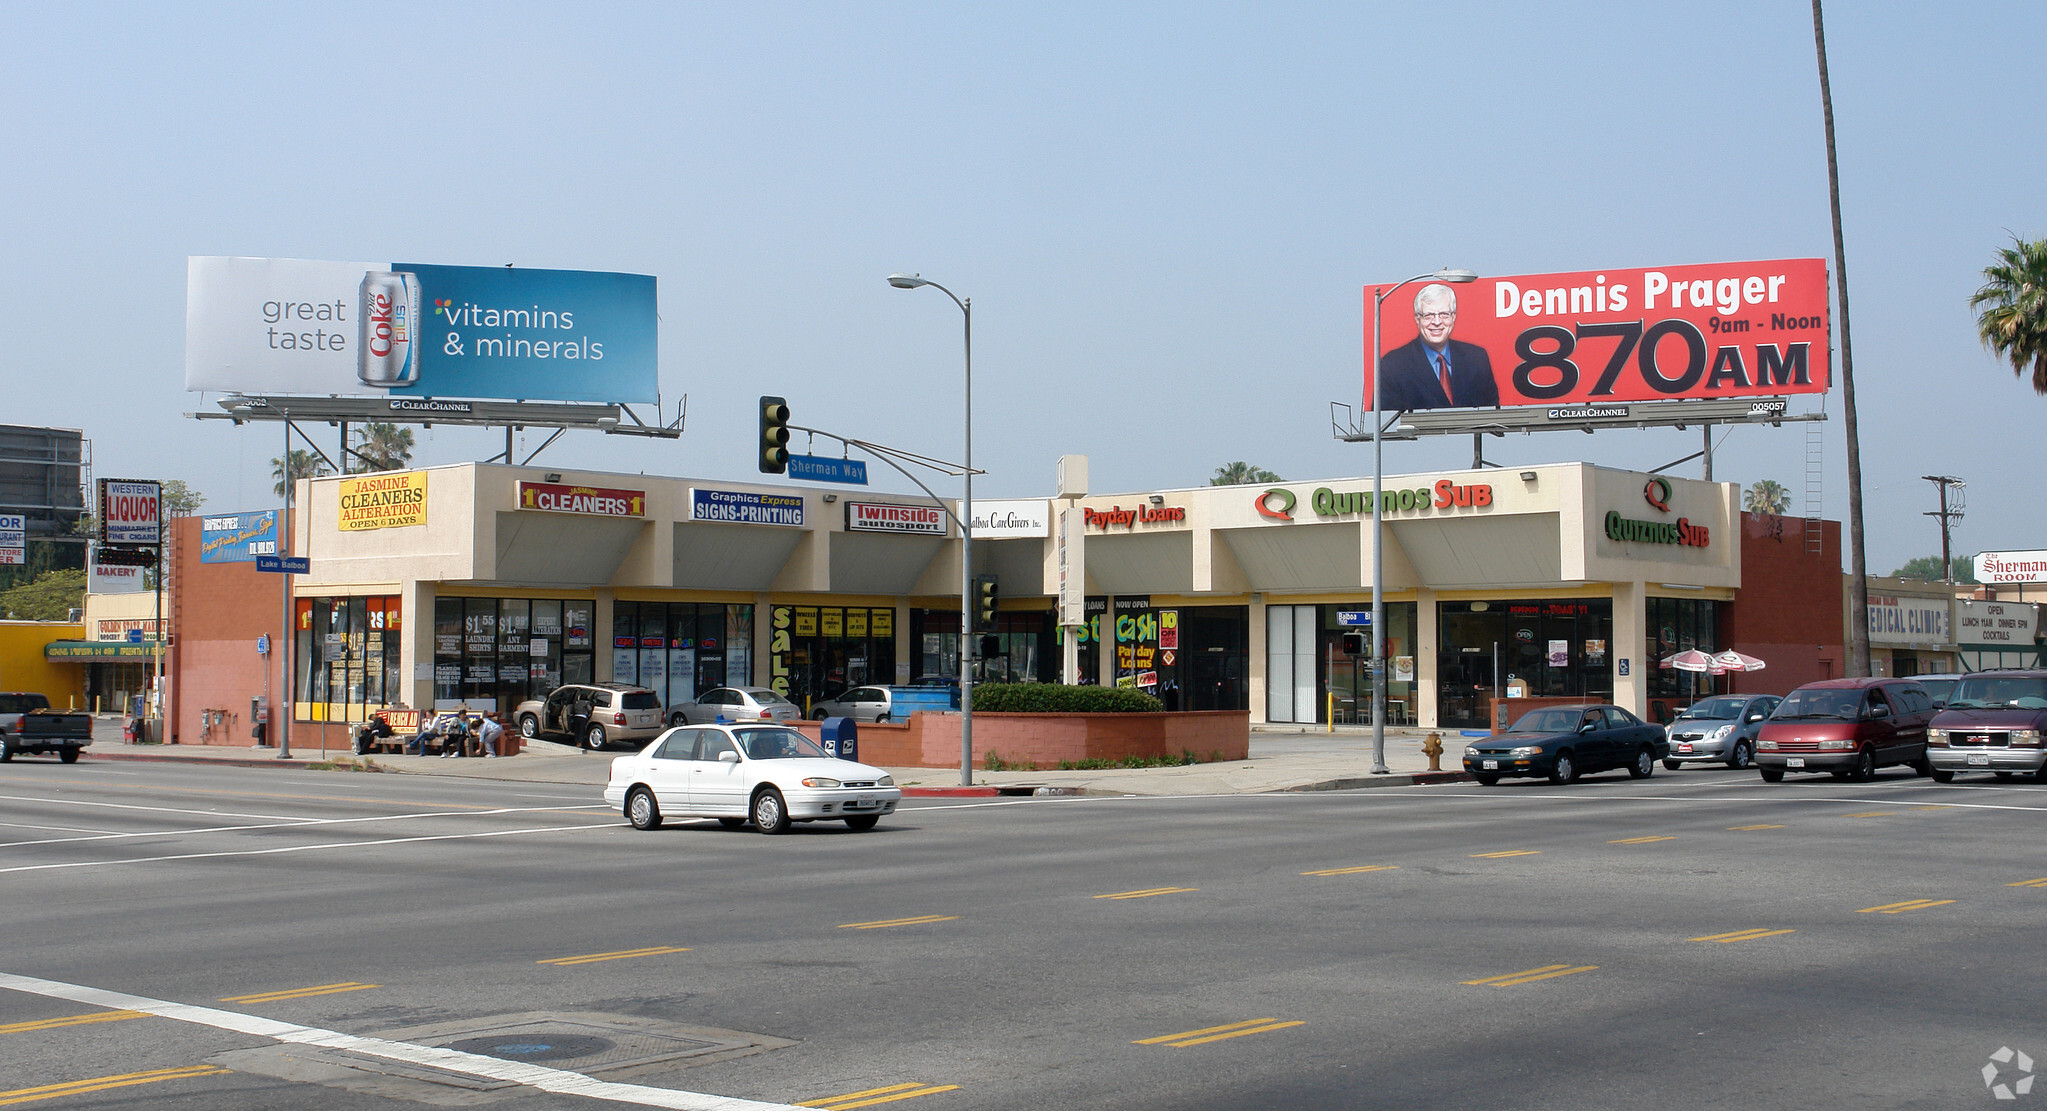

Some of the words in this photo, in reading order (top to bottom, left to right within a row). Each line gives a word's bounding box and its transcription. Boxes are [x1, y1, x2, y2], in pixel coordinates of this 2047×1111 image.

[1495, 275, 1628, 318] Dennis
[1644, 271, 1786, 316] Prager
[262, 299, 346, 324] great
[445, 302, 574, 330] vitamins
[370, 293, 393, 357] Coke
[393, 305, 409, 342] plus
[1709, 316, 1750, 334] 9am
[1771, 313, 1822, 331] Noon
[267, 327, 346, 351] taste
[444, 332, 465, 356] &
[476, 335, 604, 361] minerals
[1752, 402, 1786, 412] 005057
[791, 459, 838, 476] Sherman
[842, 463, 864, 480] Way
[112, 484, 154, 495] WESTERN
[354, 476, 409, 494] JASMINE
[568, 487, 598, 497] JASMINE
[340, 487, 423, 510] CLEANERS
[537, 492, 628, 516] CLEANERS
[710, 491, 759, 504] Graphics
[760, 495, 801, 507] Express
[1311, 487, 1430, 516] Quiznos
[108, 496, 157, 523] LIQUOR
[342, 503, 422, 521] ALTERATION
[696, 502, 802, 524] SIGNS-PRINTING
[857, 504, 939, 523] Twinside
[1084, 505, 1136, 530] Payday
[1138, 503, 1185, 524] Loans
[350, 519, 379, 528] OPEN
[380, 518, 387, 527] 6
[388, 516, 416, 526] DAYS
[858, 519, 940, 531] autosport
[971, 516, 989, 529] alboa
[990, 511, 1029, 529] CareGivers
[1604, 510, 1678, 544] Quiznos
[108, 525, 157, 533] MINIMARKET
[129, 533, 157, 541] CIGARS
[96, 567, 137, 577] BAKERY
[260, 560, 278, 568] Lake
[281, 561, 306, 570] Balboa
[1982, 559, 2047, 574] Sherman
[1994, 573, 2037, 581] ROOM
[1116, 601, 1131, 609] NOW
[1132, 600, 1149, 609] OPEN
[1987, 605, 2004, 615] OPEN
[100, 621, 121, 633] GOLDEN
[465, 615, 495, 634] $1.55
[1162, 612, 1177, 629] 10
[1869, 607, 1906, 633] EDICAL
[1908, 608, 1942, 635] CLINIC
[1962, 617, 1979, 627] LUNCH
[1998, 618, 2016, 629] DINNER
[465, 635, 495, 643] LAUNDRY
[507, 636, 521, 644] ANY
[1983, 630, 2010, 641] COCKTAILS
[468, 644, 492, 652] SHIRTS
[498, 645, 529, 653] GARMENT
[389, 711, 409, 727] BENCH
[408, 711, 419, 727] AD
